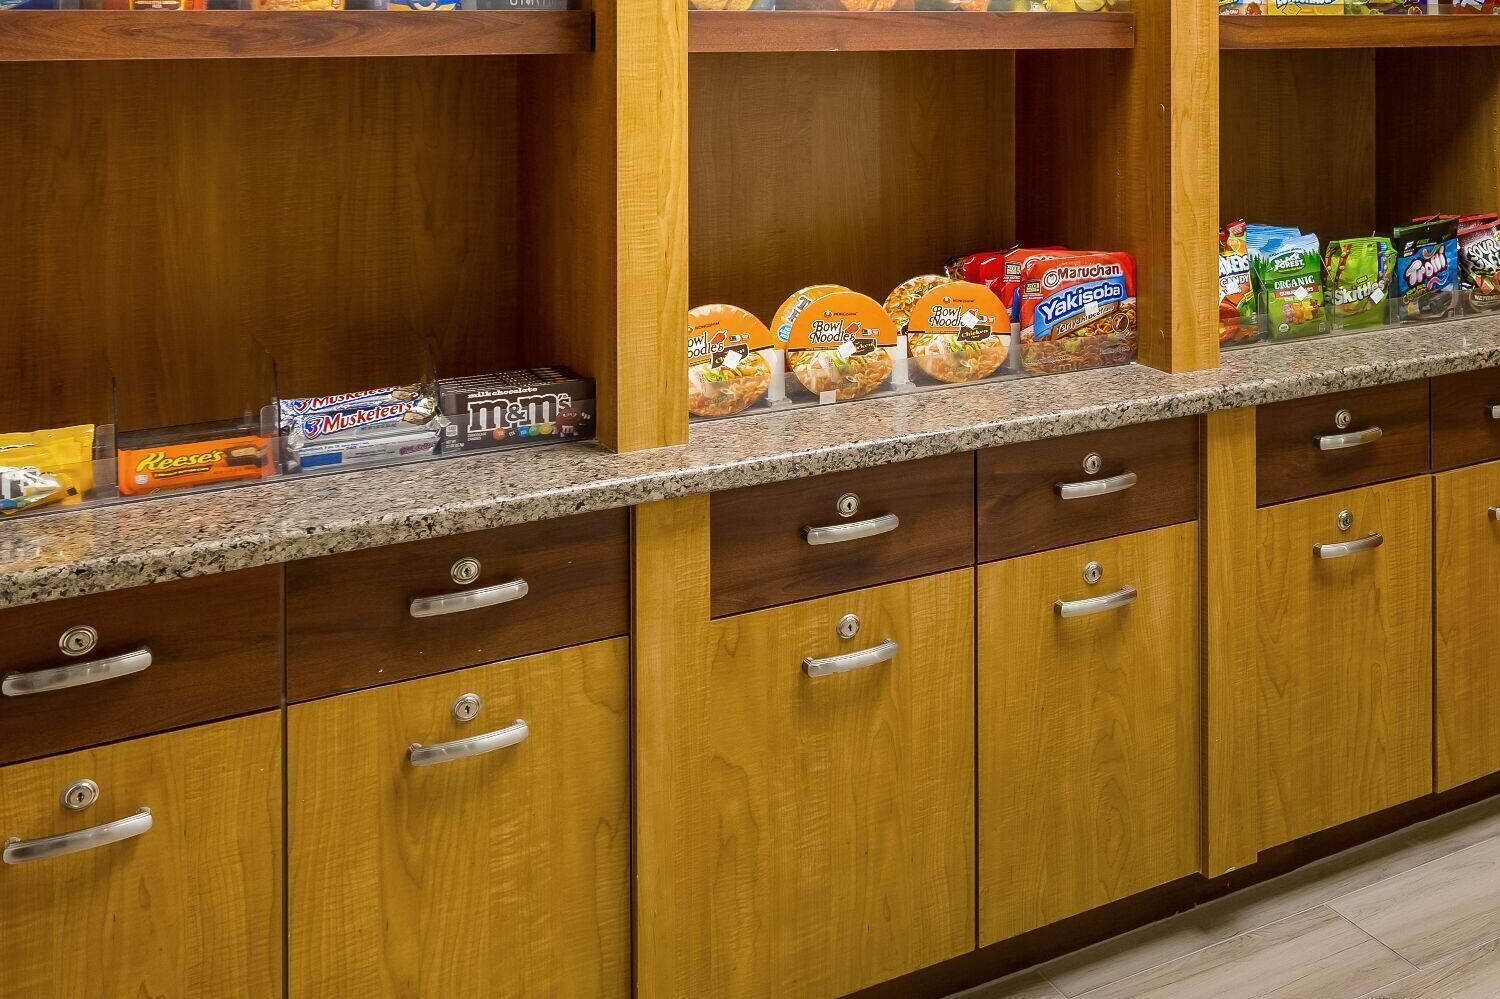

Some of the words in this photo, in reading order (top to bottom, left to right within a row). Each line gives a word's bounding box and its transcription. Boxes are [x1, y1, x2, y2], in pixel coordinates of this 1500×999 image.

[1466, 239, 1495, 260] SOUR
[1057, 264, 1121, 281] Maruchan
[1273, 259, 1305, 271] FOREST
[1405, 245, 1447, 287] Trolli
[1220, 274, 1249, 287] CANDY
[1274, 274, 1315, 290] ORGANIC
[1334, 279, 1385, 306] Skittles
[931, 305, 962, 318] Bowl
[1040, 283, 1123, 323] Yakisoba
[812, 319, 844, 332] Bowl
[1055, 312, 1088, 335] Teriyaki
[809, 331, 856, 344] Noodles
[961, 327, 990, 339] Chicken
[467, 390, 492, 399] milk
[491, 386, 538, 397] chocolate
[304, 417, 324, 439] 3
[322, 400, 414, 435] Musketeers
[466, 393, 572, 434] m&m's
[136, 449, 226, 473] Reese's
